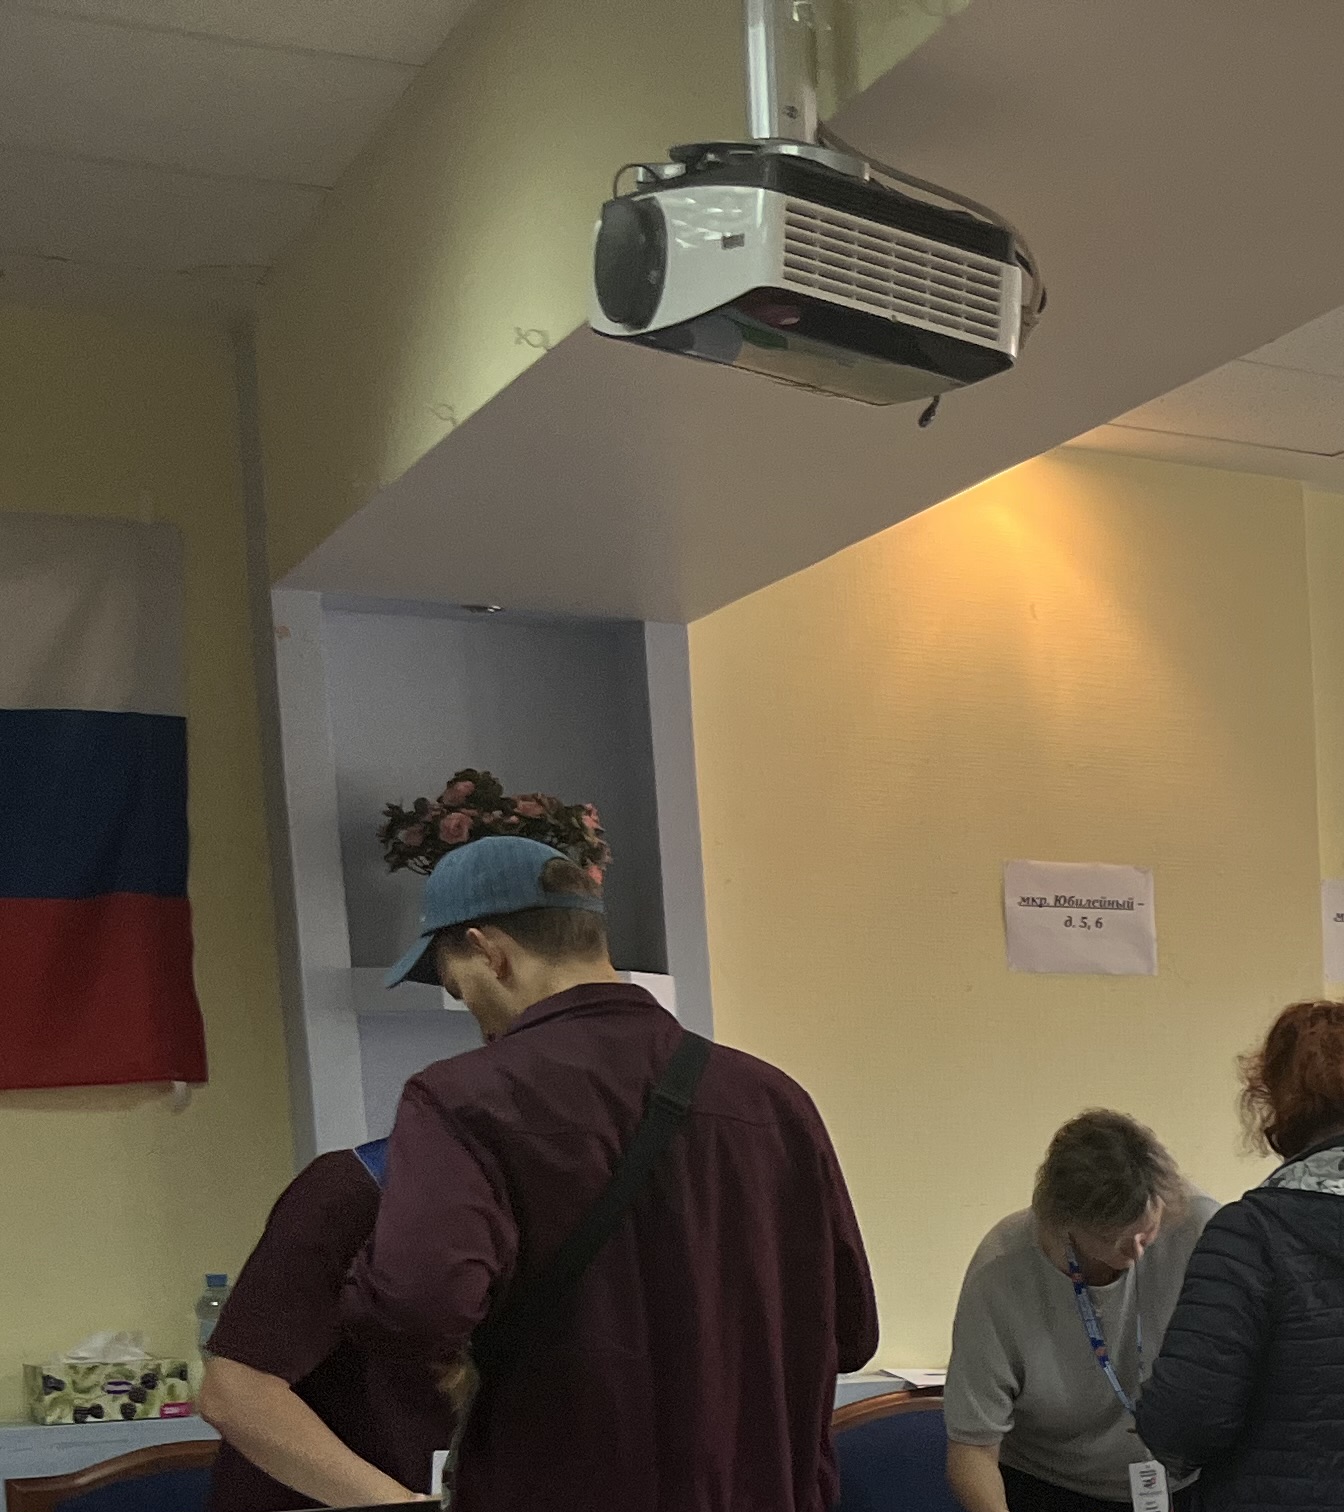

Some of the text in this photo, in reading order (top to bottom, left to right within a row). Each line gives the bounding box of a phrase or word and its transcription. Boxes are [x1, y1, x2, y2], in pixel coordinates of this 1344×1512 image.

[1017, 896, 1050, 908] мкр.
[1054, 894, 1135, 911] Юбилейный
[1064, 916, 1104, 930] д. 5, 6
